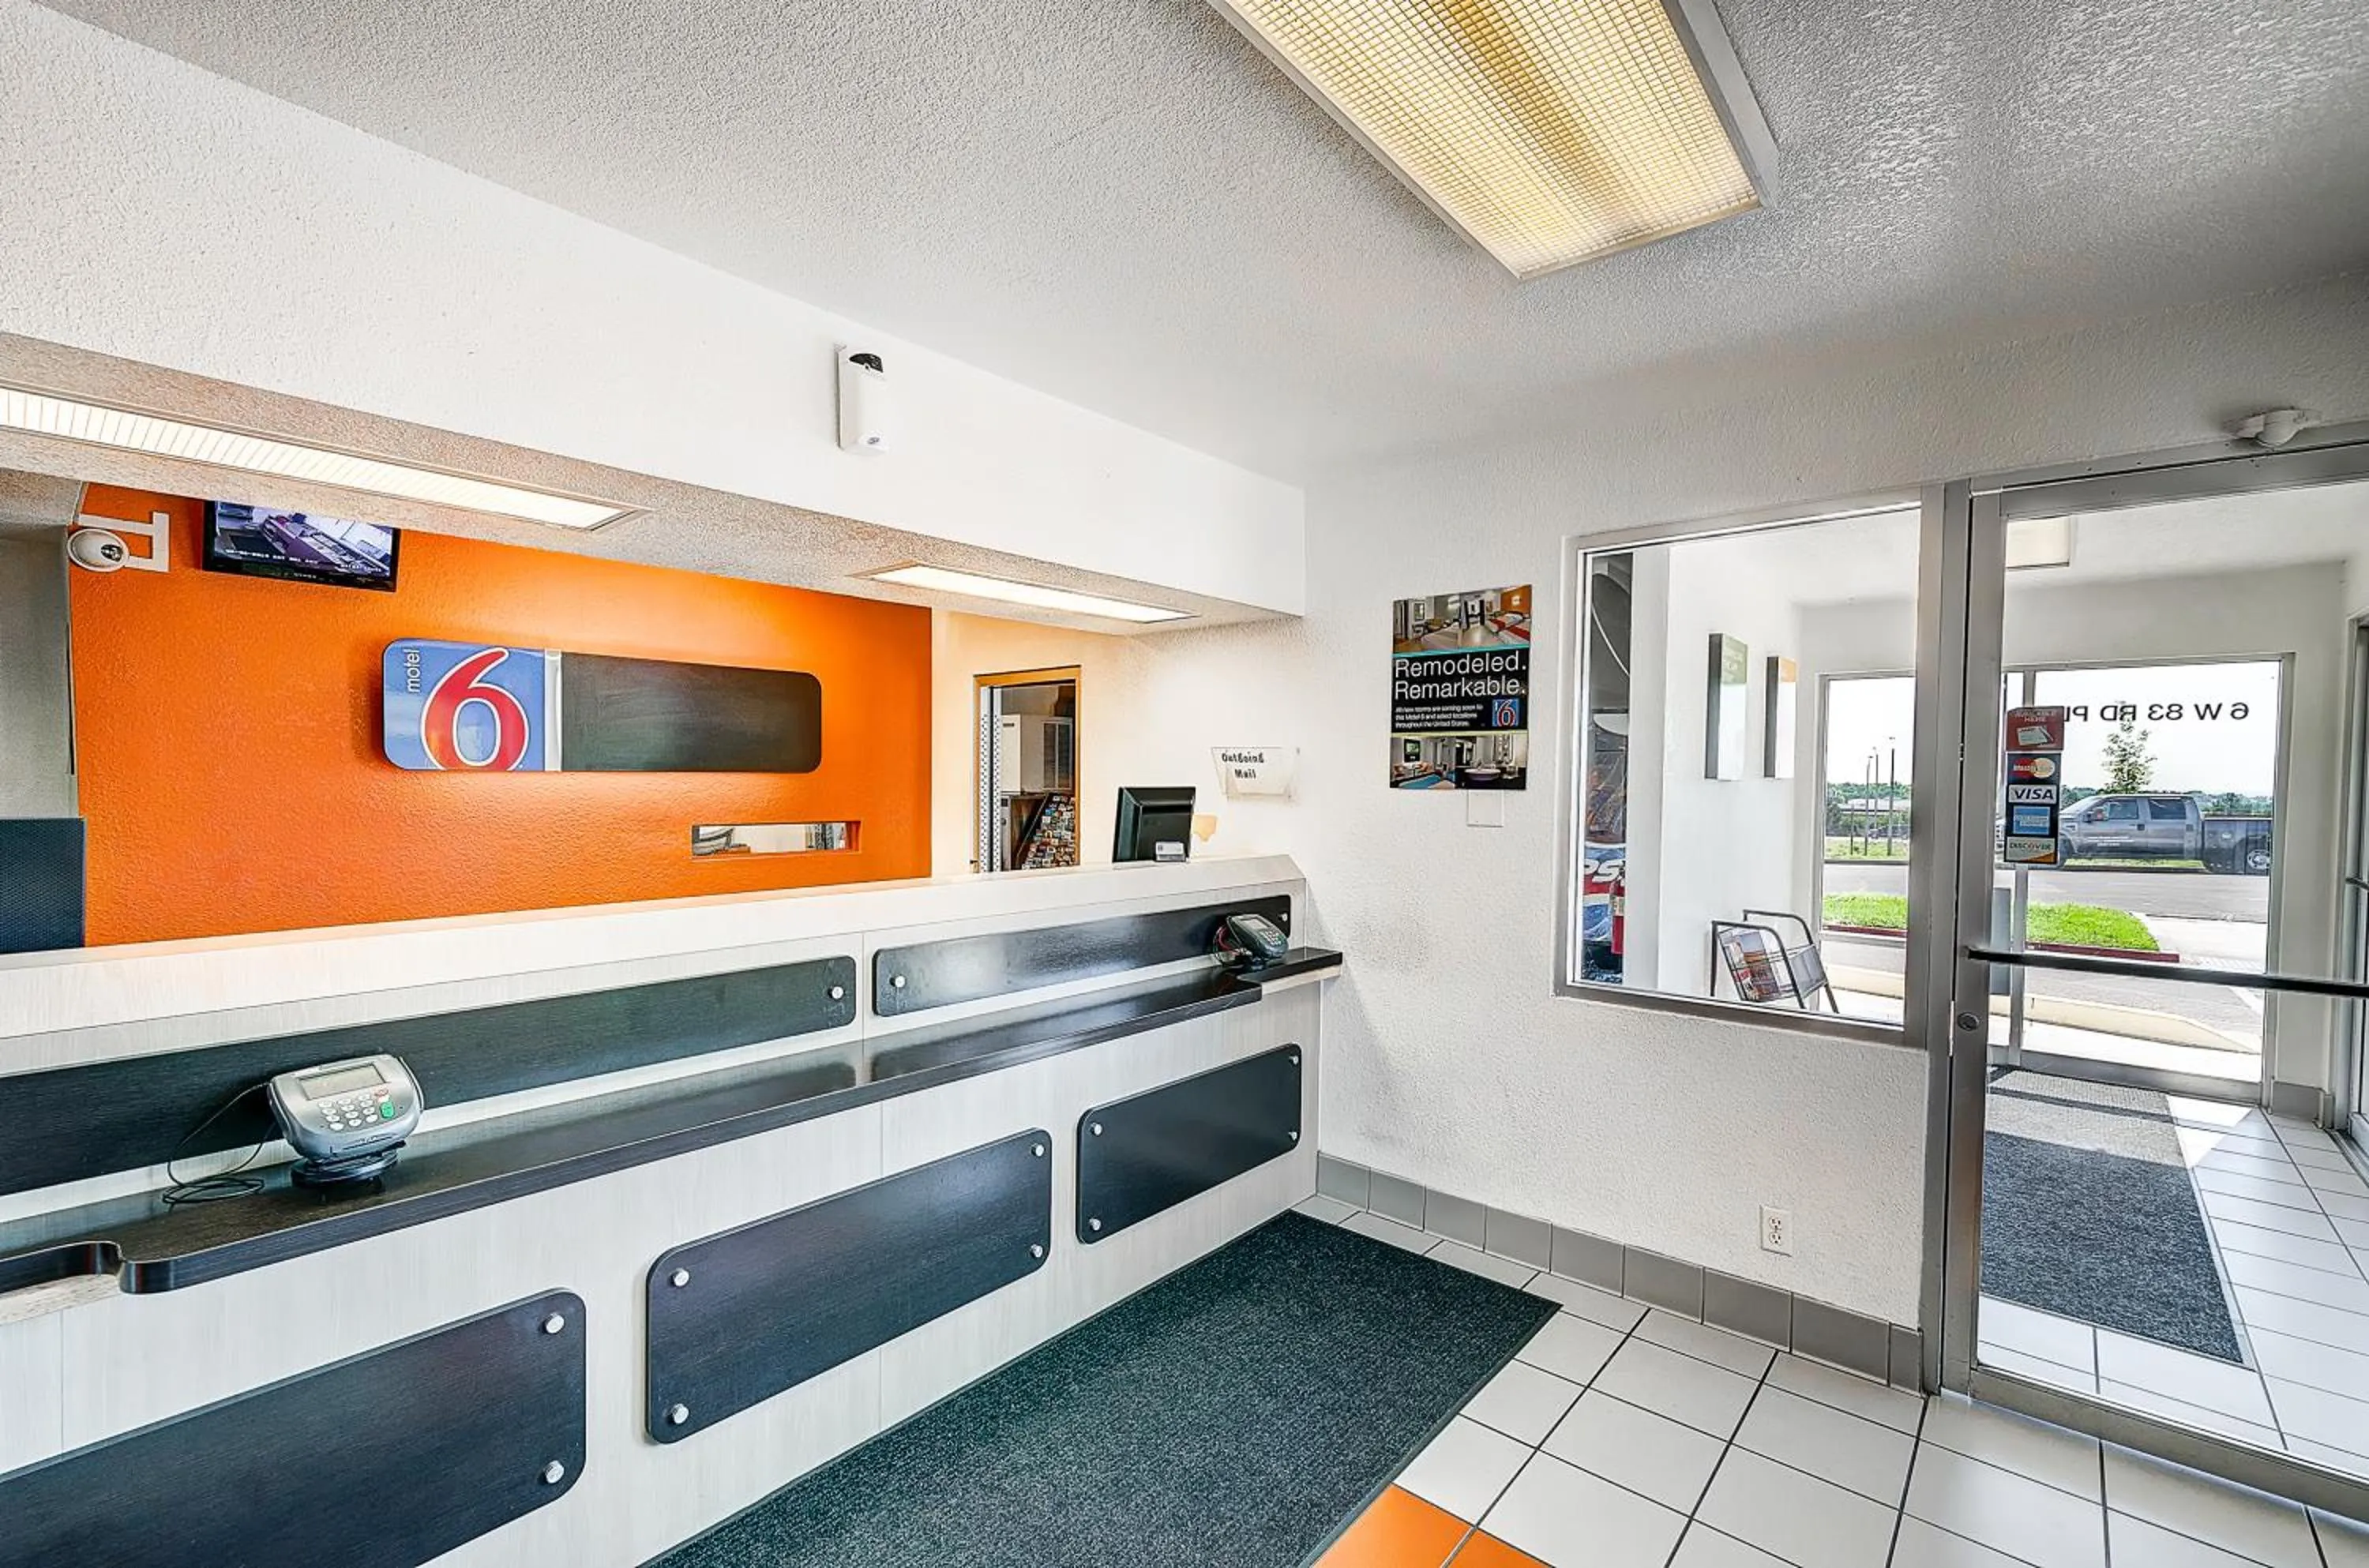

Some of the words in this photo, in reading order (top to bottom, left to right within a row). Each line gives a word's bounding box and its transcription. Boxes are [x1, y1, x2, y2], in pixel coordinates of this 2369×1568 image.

[402, 648, 420, 692] motel
[1395, 651, 1526, 678] Remodeled.
[1395, 675, 1526, 700] Remarkable.
[420, 647, 529, 771] 6
[1498, 699, 1515, 726] 6
[1234, 768, 1256, 779] Mail
[2014, 788, 2054, 800] VISA
